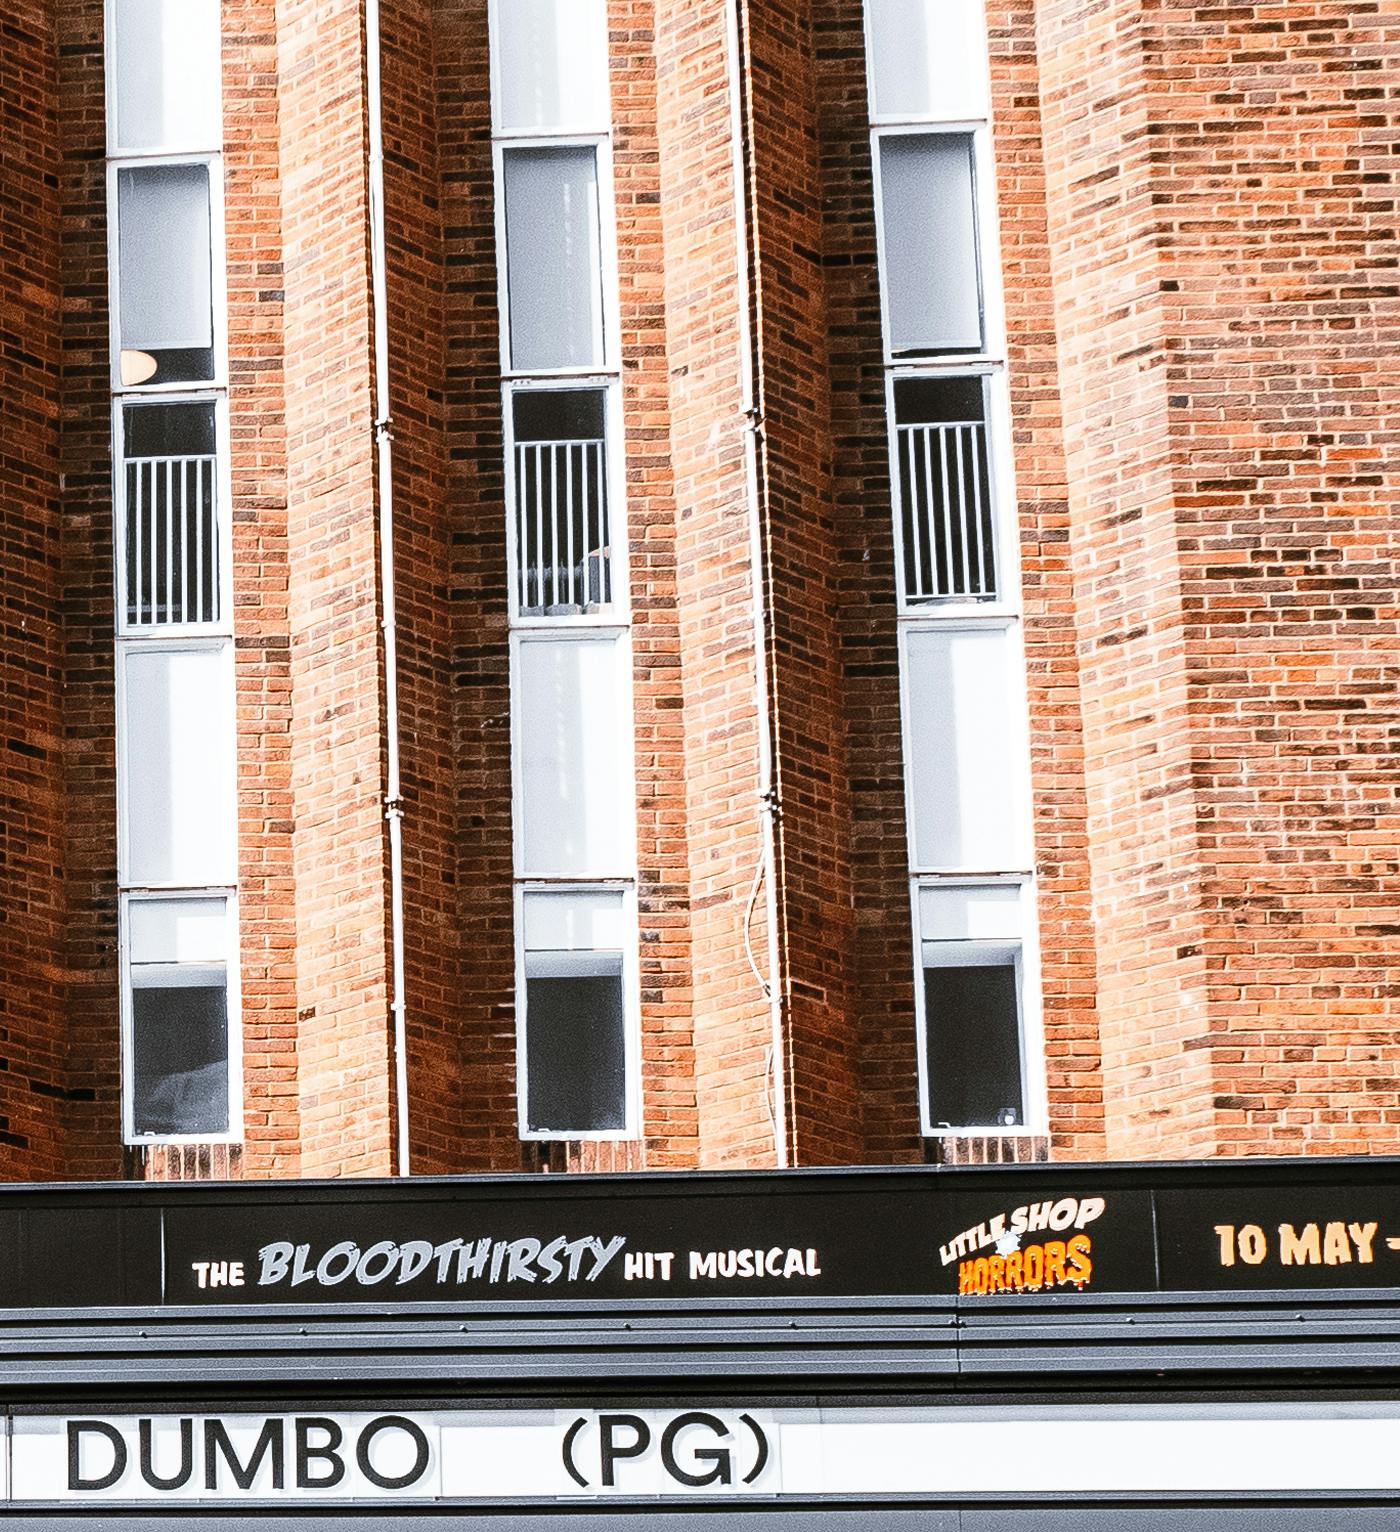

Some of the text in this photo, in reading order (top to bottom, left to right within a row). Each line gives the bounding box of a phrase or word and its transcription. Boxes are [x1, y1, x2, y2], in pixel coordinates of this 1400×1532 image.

[192, 1234, 822, 1288] THE BLOODTHIRSTY HIT MUSICAL
[939, 1197, 1105, 1266] LITTLE SHOP
[1214, 1222, 1379, 1267] 10 MAY
[958, 1234, 1092, 1295] HORRORS
[67, 1411, 769, 1491] DUMBO (PG)
